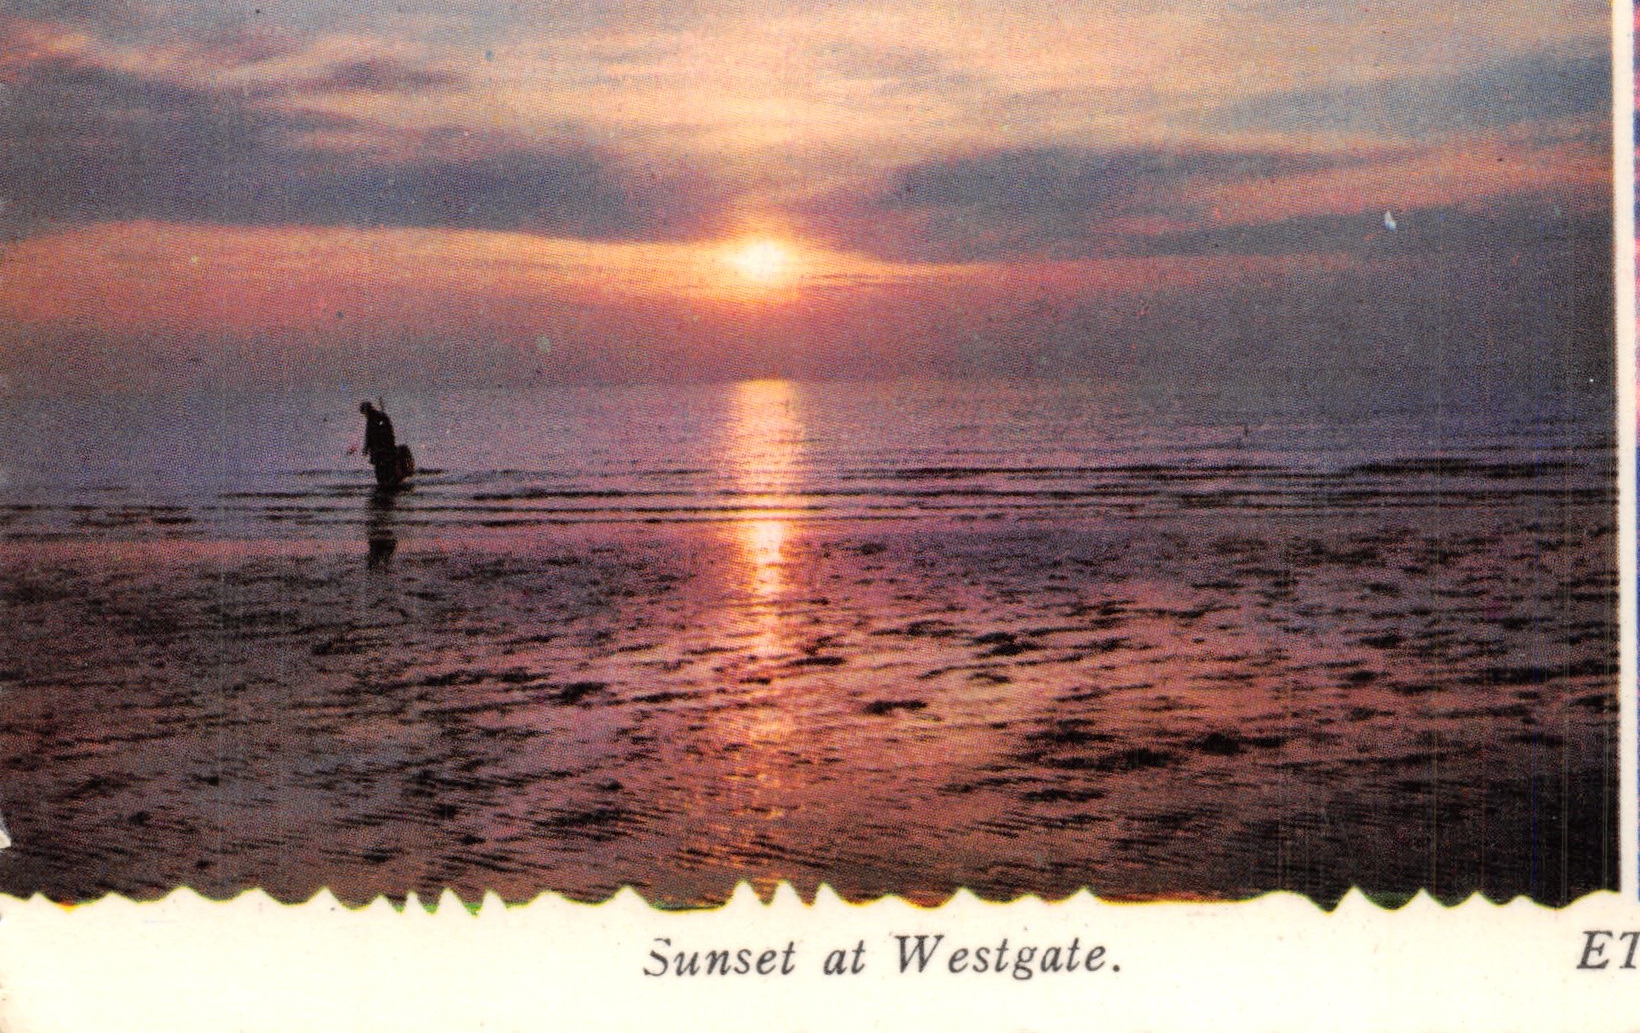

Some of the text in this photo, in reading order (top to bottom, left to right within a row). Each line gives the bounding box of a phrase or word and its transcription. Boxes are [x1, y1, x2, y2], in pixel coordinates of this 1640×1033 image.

[643, 934, 1121, 983] Sunset at Westgate.
